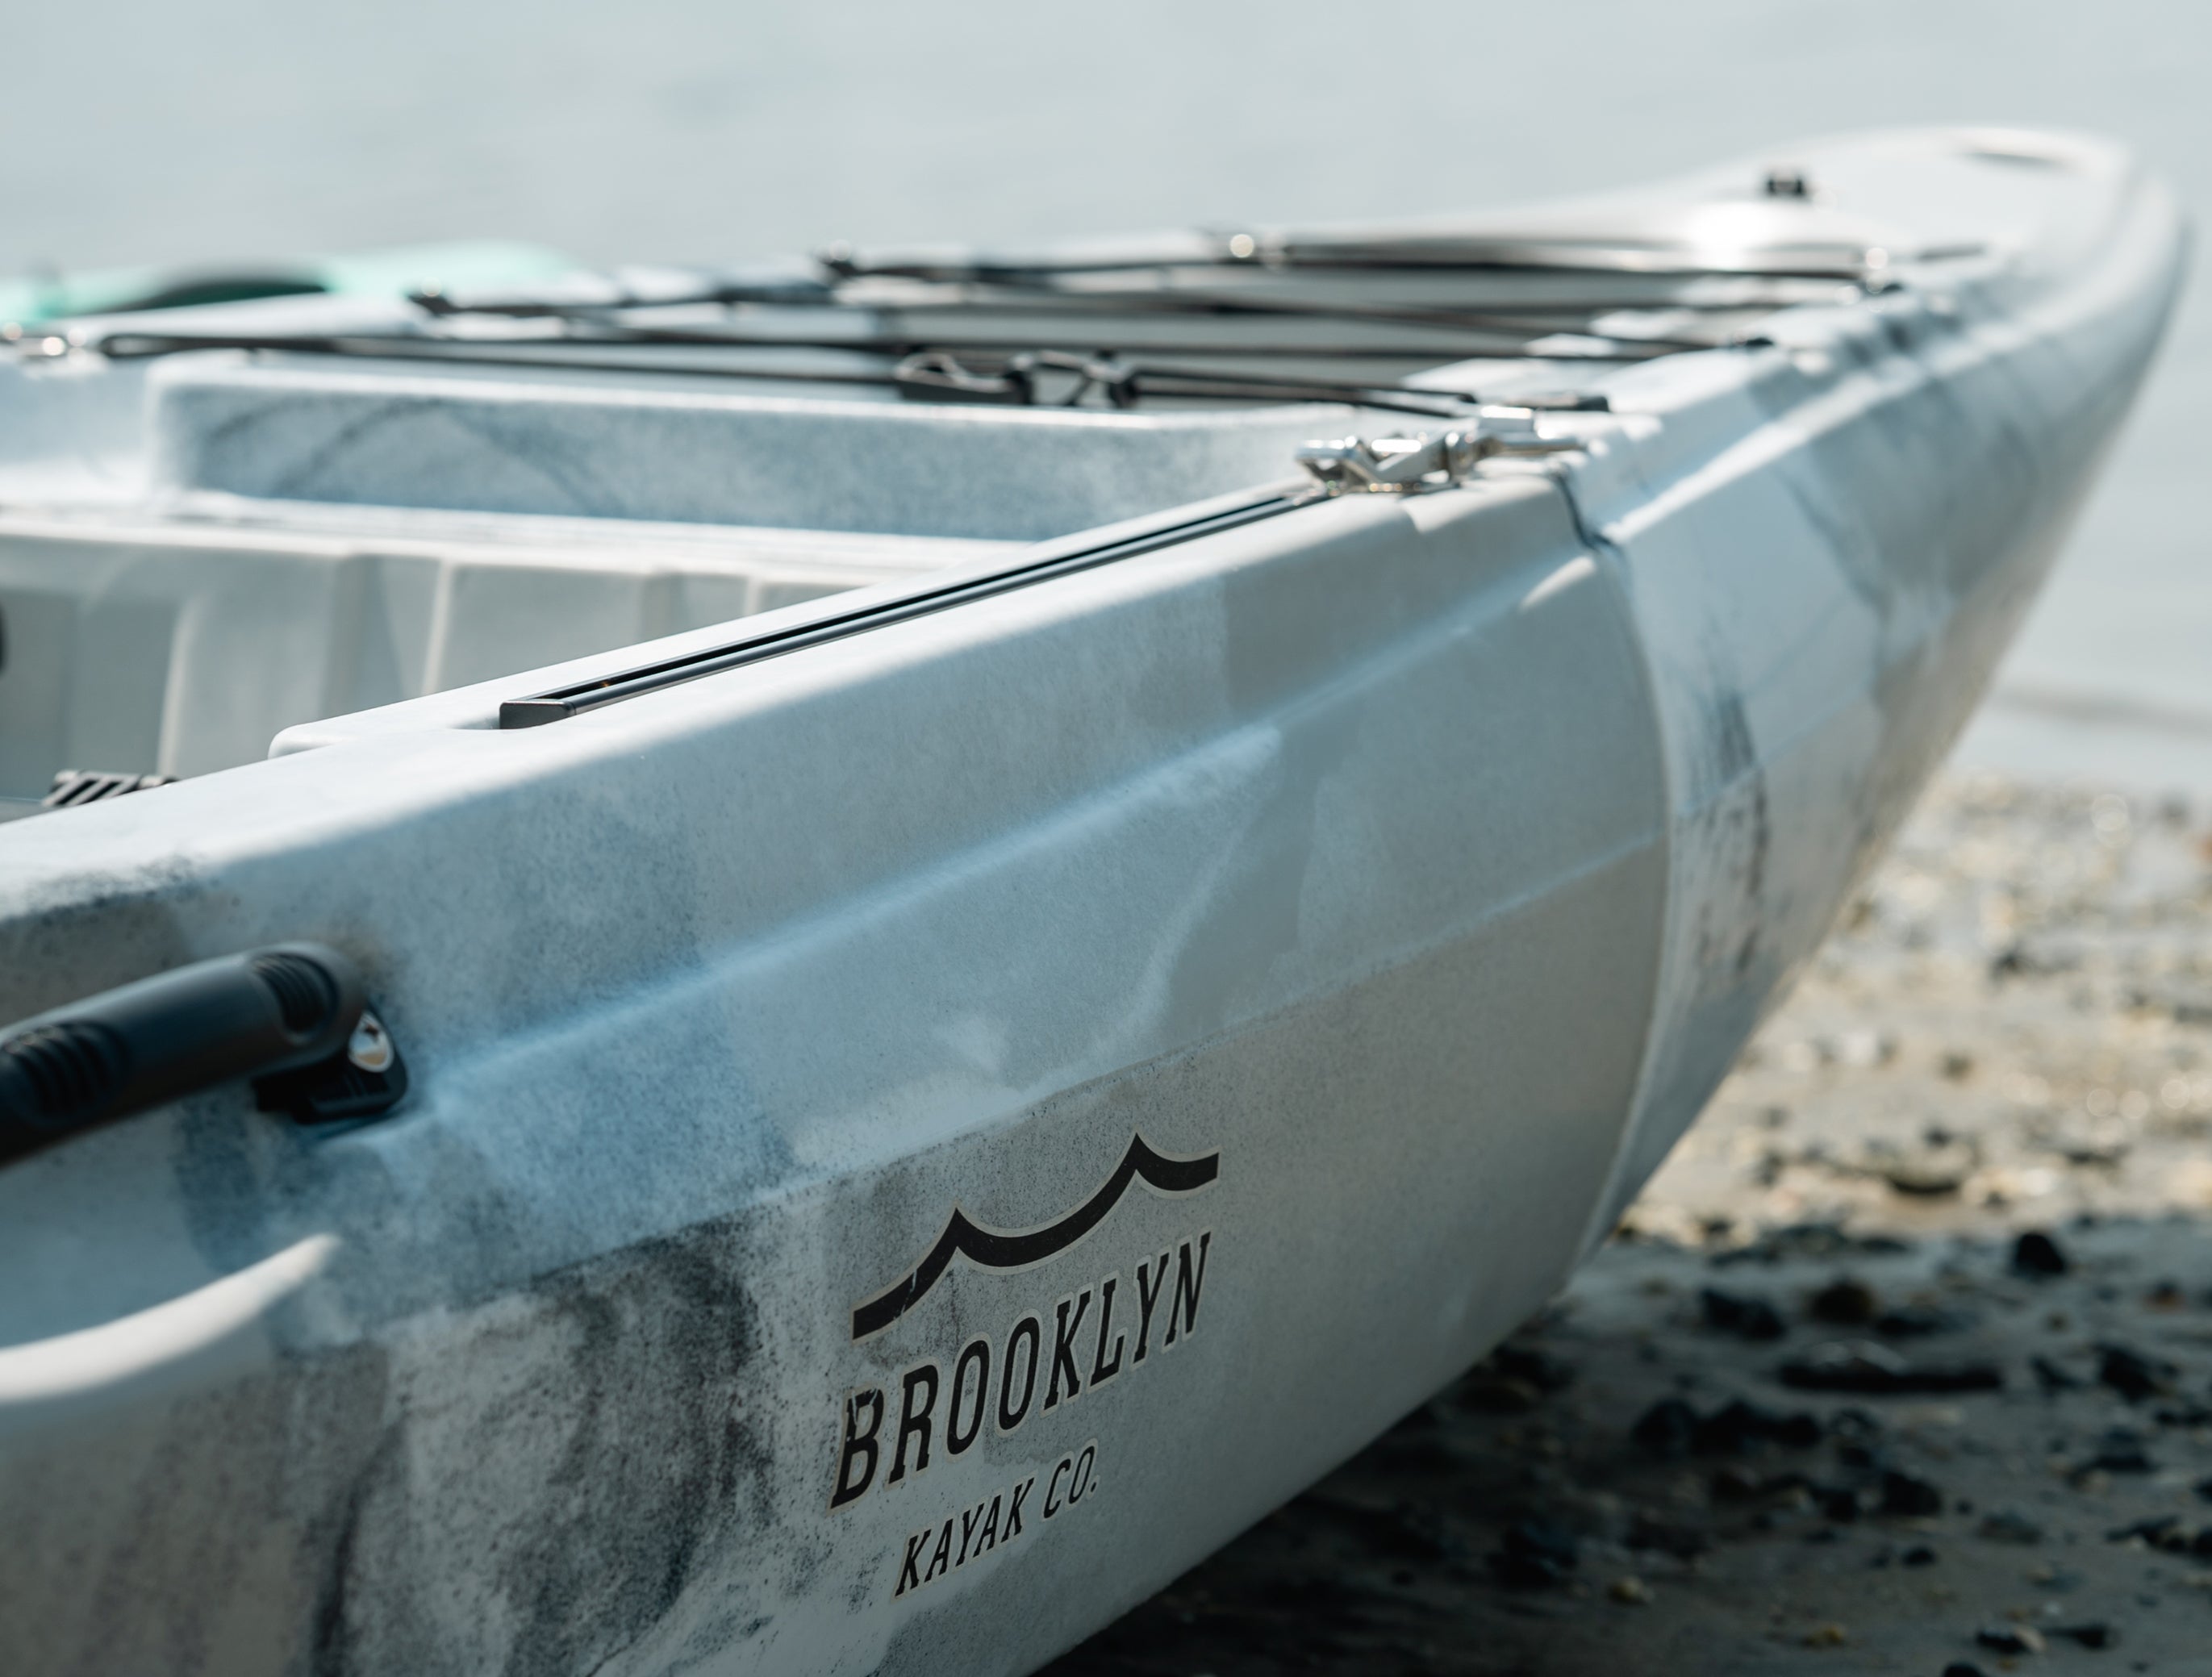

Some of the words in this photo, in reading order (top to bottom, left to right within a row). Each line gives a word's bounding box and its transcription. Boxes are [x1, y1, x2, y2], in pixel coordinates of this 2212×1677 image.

[829, 1231, 1211, 1509] BROOKLYN
[894, 1478, 1035, 1597] KAYAK
[1043, 1445, 1097, 1519] CO.
